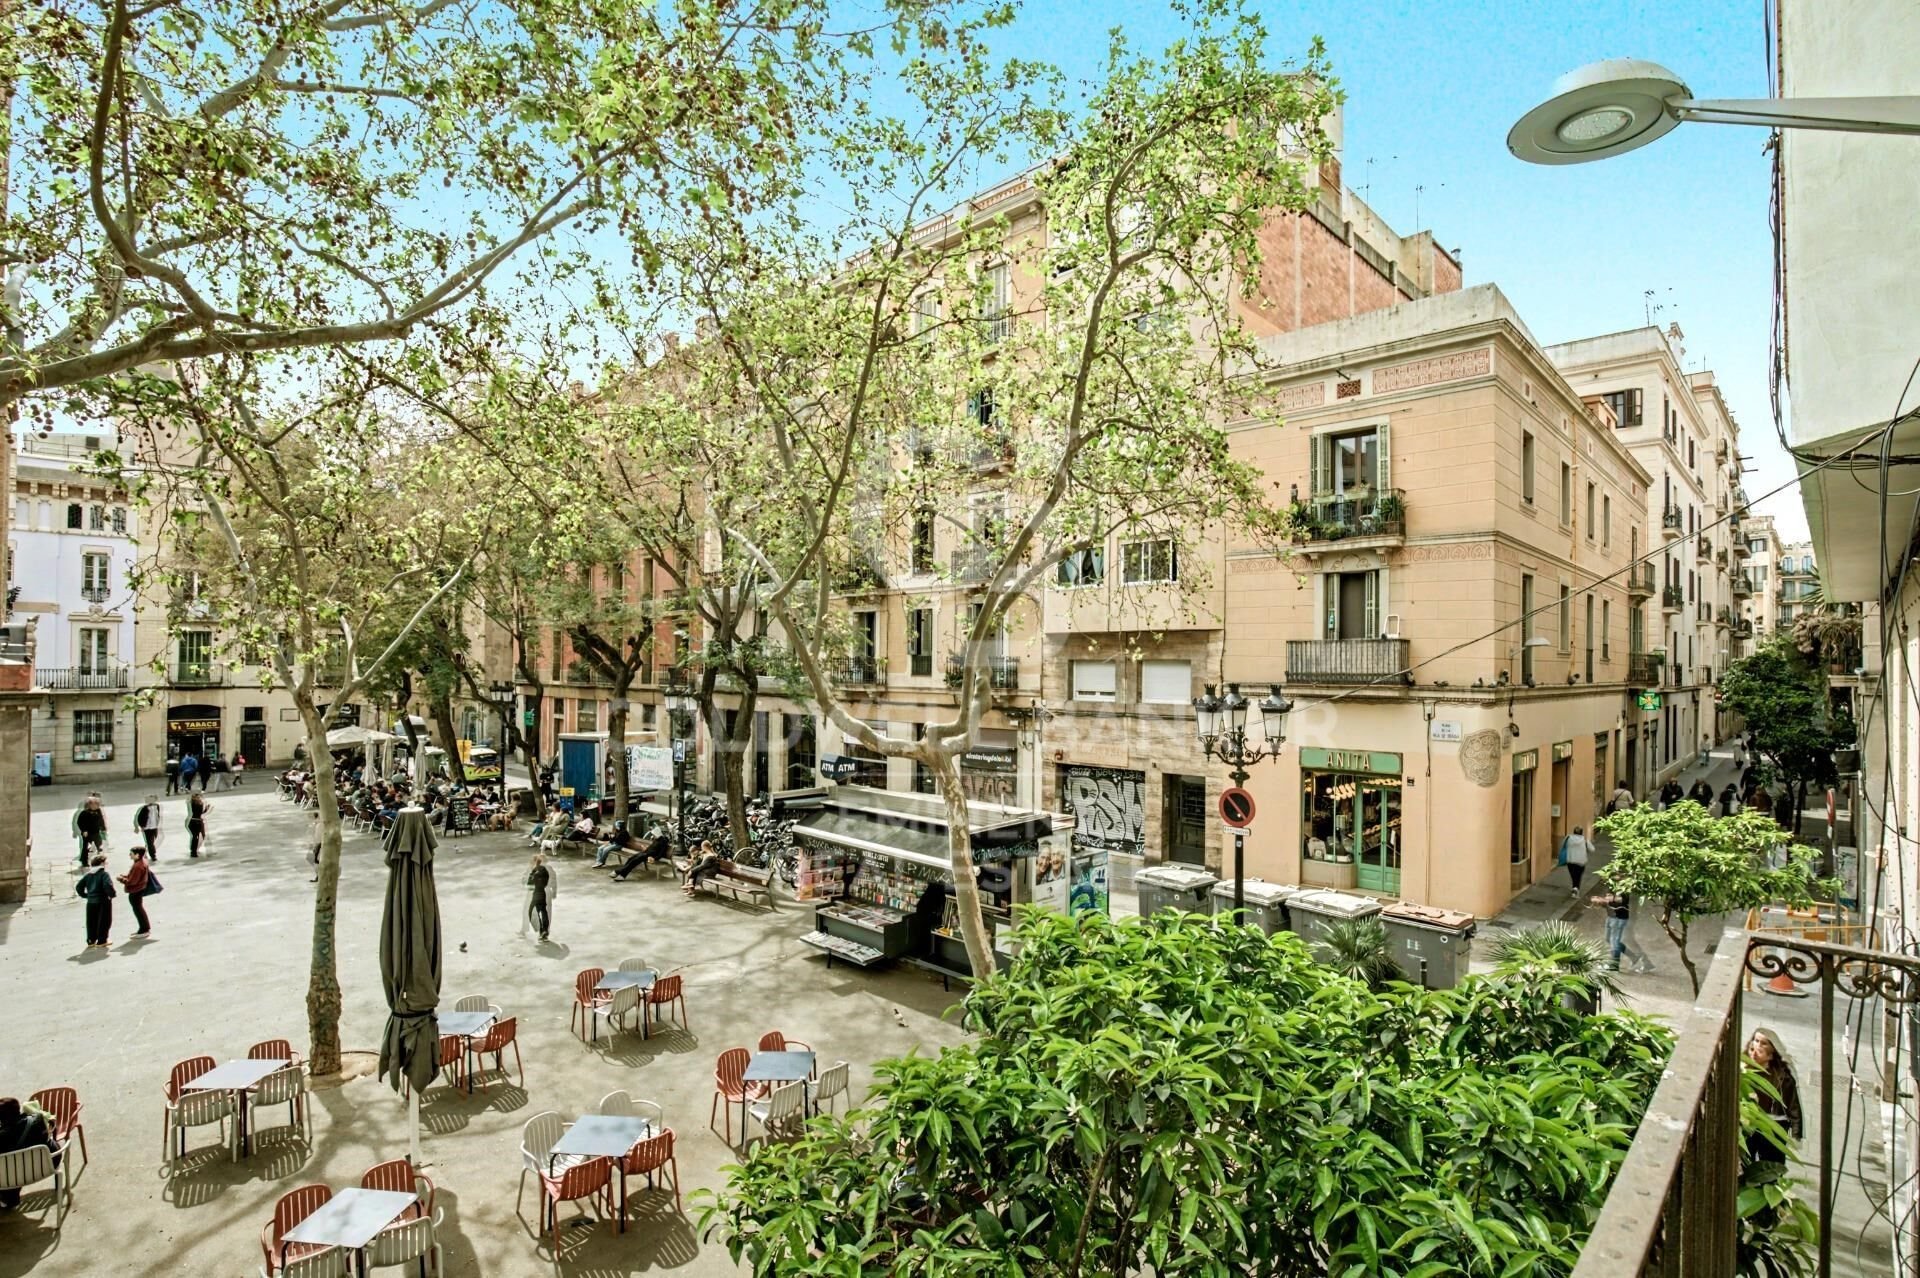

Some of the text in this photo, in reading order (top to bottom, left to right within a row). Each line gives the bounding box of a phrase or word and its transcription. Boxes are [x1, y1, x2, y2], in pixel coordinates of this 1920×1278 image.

[1328, 752, 1369, 769] ANITA
[822, 762, 835, 772] ATM
[838, 762, 856, 773] ATM
